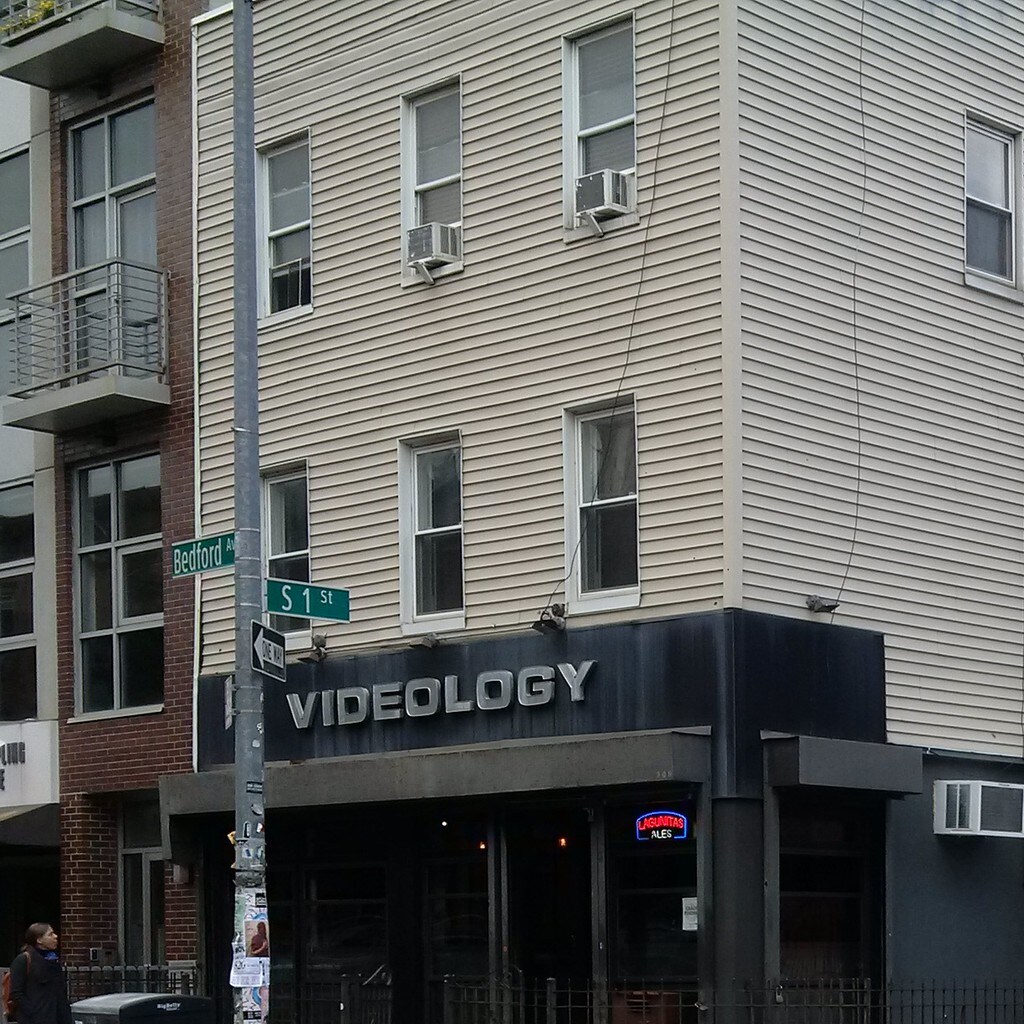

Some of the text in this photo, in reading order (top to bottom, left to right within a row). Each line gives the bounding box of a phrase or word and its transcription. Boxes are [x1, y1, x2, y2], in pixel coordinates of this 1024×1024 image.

[174, 538, 222, 574] Bedford
[281, 585, 333, 613] S 1 St
[262, 639, 272, 660] ONE
[286, 659, 598, 729] VIDEOLOGY
[0, 742, 25, 765] LING
[637, 815, 684, 830] LAGUNITAS
[651, 829, 673, 839] ALES
